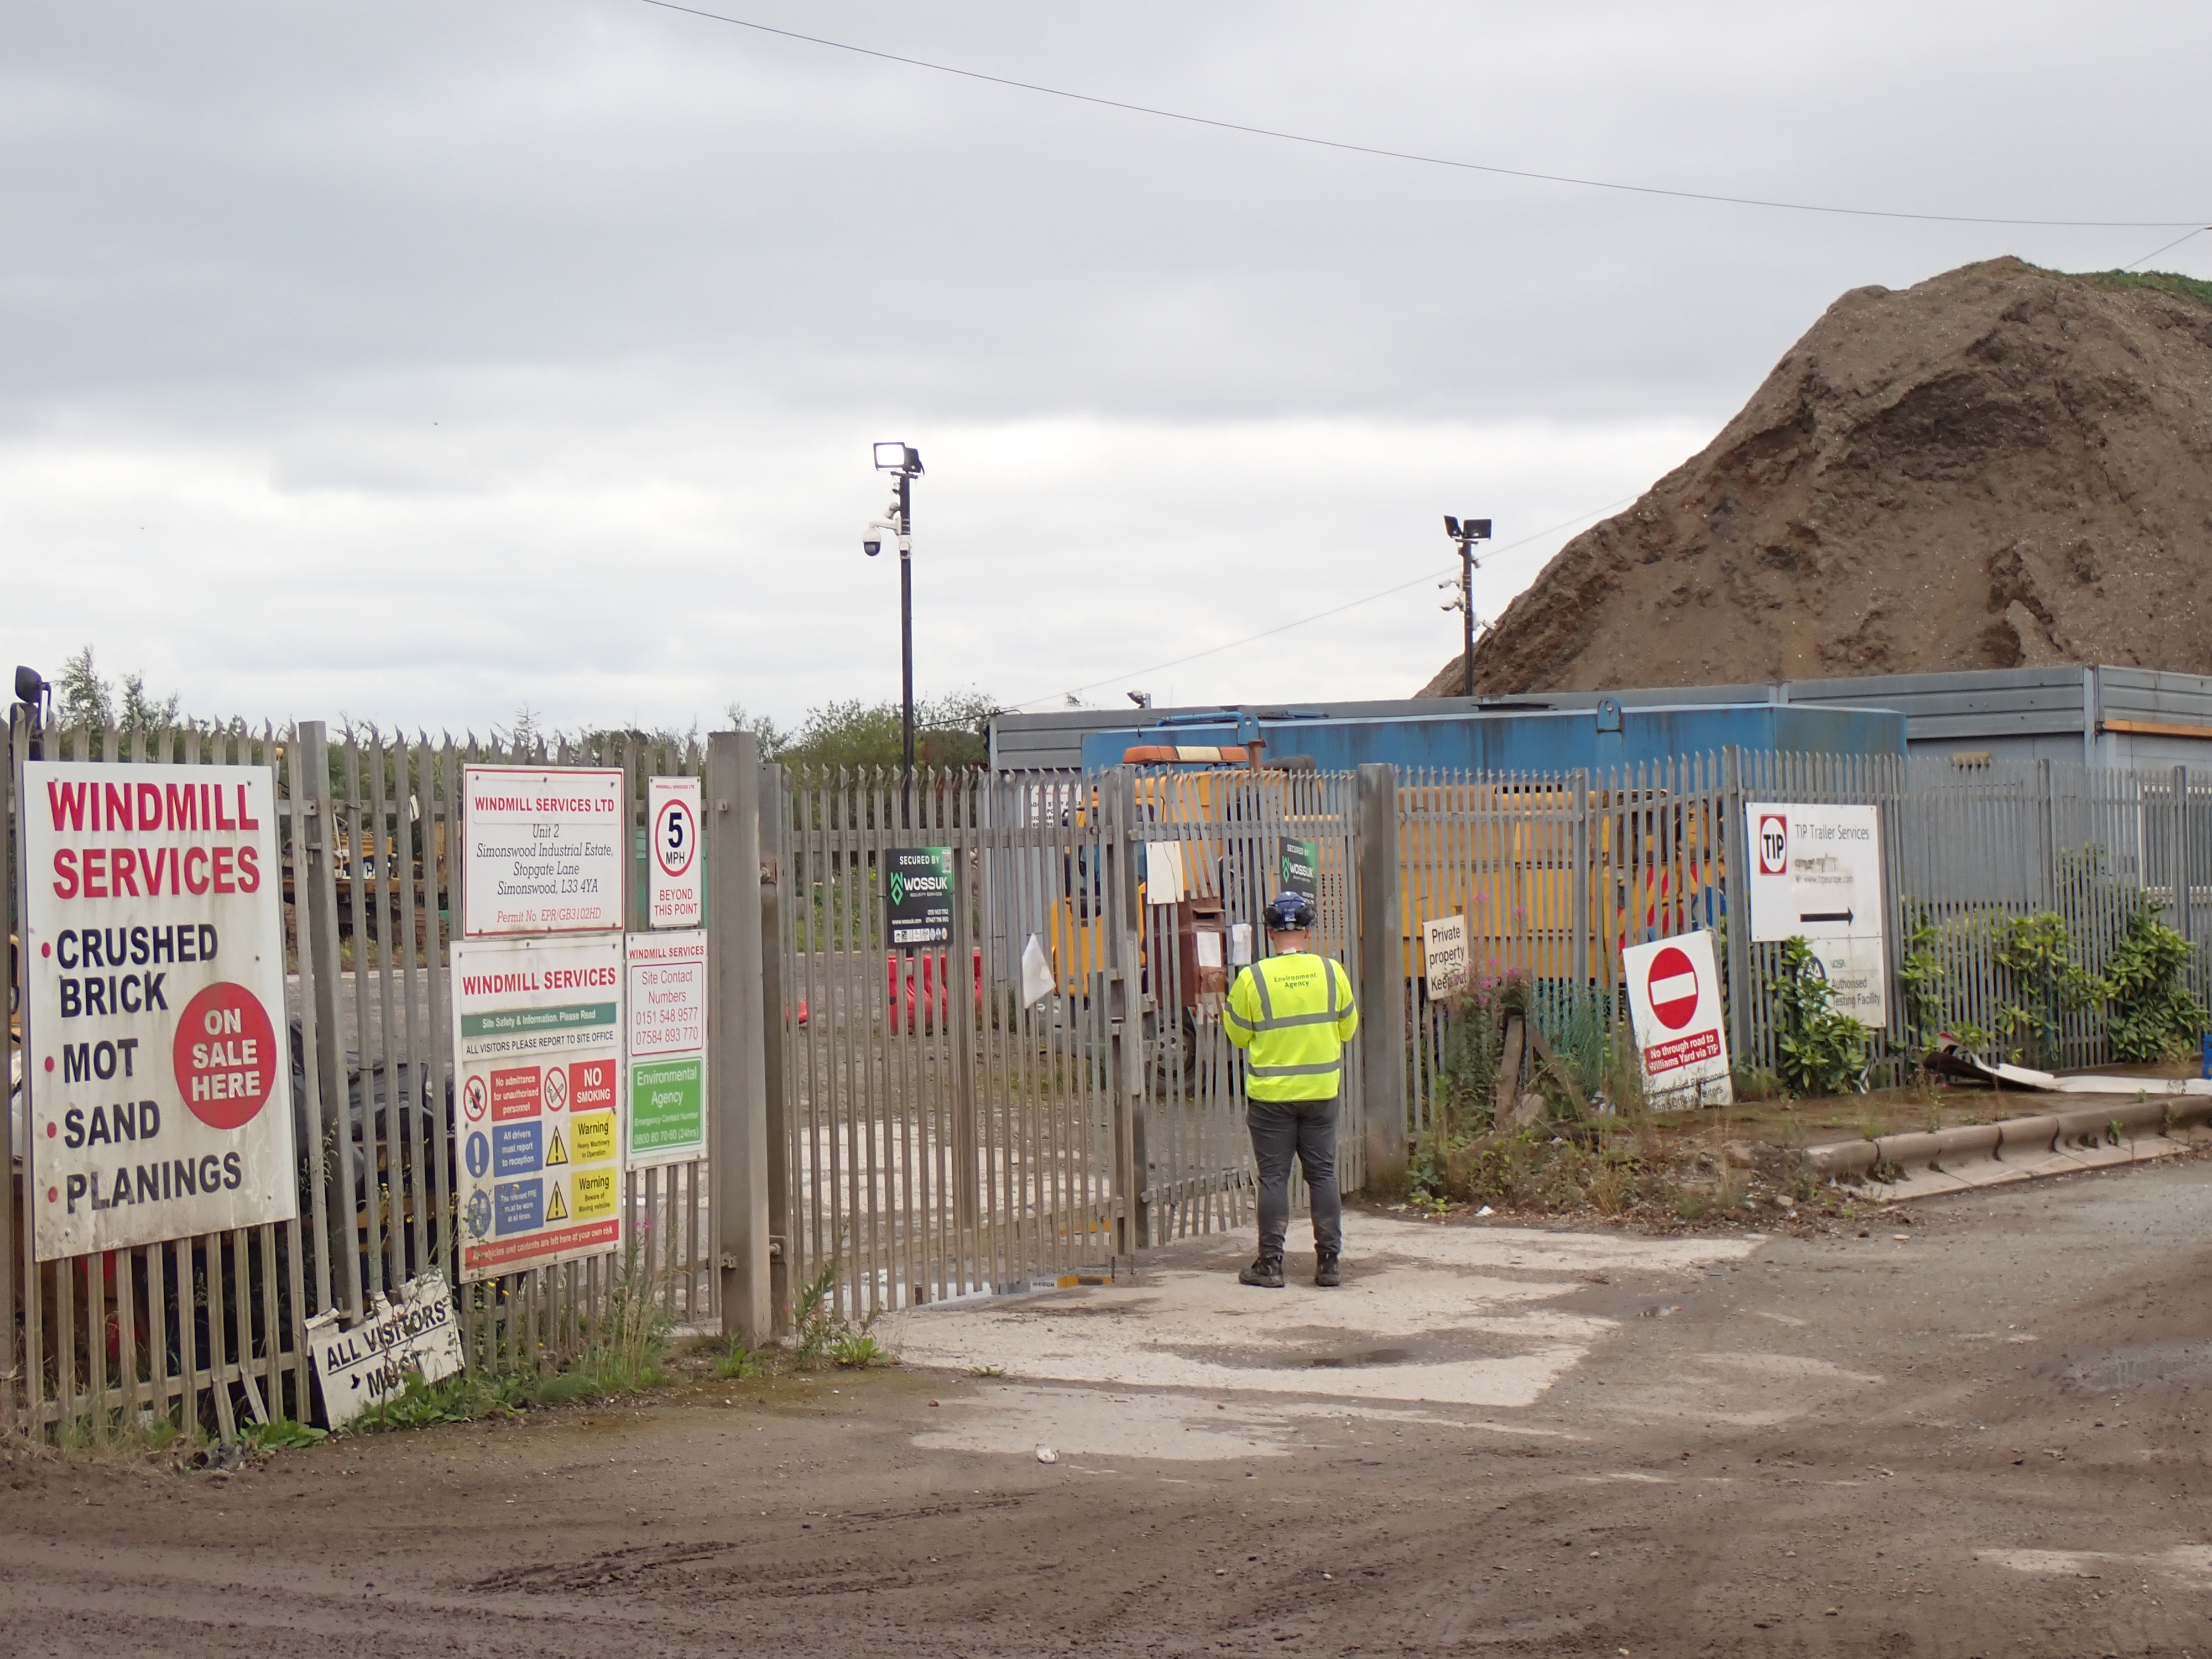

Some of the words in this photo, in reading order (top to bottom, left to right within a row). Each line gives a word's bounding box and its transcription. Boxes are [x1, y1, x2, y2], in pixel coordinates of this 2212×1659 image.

[48, 781, 259, 831] WINDMILL
[475, 797, 532, 811] WINDMILL
[536, 798, 591, 812] SERVICES
[596, 799, 614, 812] LTD
[533, 824, 551, 838] Unit
[554, 825, 560, 838] 2
[667, 812, 683, 848] 5
[1794, 825, 1807, 838] TIP
[1810, 825, 1835, 839] Trailer
[1838, 825, 1869, 839] Services
[477, 843, 536, 857] Simonswood
[539, 842, 582, 857] Industrial
[585, 842, 613, 857] Estate,
[1287, 844, 1303, 855] SECURED
[1763, 834, 1784, 859] TIP
[666, 852, 685, 865] MPH
[899, 855, 930, 865] SECURED
[931, 855, 940, 864] BY
[53, 846, 260, 899] SERVICES
[514, 862, 554, 879] Stopgate
[557, 861, 580, 875] Lane
[1290, 862, 1313, 878] WOSSUK
[498, 880, 557, 895] Simonswood,
[561, 879, 578, 893] L33
[581, 879, 598, 893] 4YA
[904, 877, 948, 891] WOSSUK
[660, 889, 693, 901] BEYOND
[497, 910, 524, 922] Permit
[526, 910, 536, 922] No
[655, 904, 672, 916] THIS
[675, 903, 698, 915] POINT
[1432, 925, 1460, 943] Private
[57, 924, 218, 969] CRUSHED
[629, 948, 667, 959] WINDMILL
[669, 945, 704, 957] SERVICES
[1430, 945, 1464, 968] property
[1830, 959, 1846, 968] VOSA
[463, 972, 539, 995] WINDMILL
[545, 967, 615, 989] SERVICES
[642, 971, 658, 985] Site
[661, 969, 693, 984] Contact
[1274, 973, 1317, 983] Environment
[1285, 980, 1309, 989] Agency
[1832, 977, 1866, 989] Authorised
[60, 973, 169, 1018] BRICK
[649, 990, 686, 1004] Numbers
[1832, 995, 1856, 1008] Testing
[1858, 992, 1880, 1006] Facility
[205, 1008, 241, 1035] ON
[483, 1018, 494, 1029] Site
[496, 1016, 515, 1029] Safety
[517, 1015, 521, 1025] &
[560, 1011, 580, 1022] Please
[581, 1009, 596, 1019] Read
[636, 1011, 656, 1025] 0151
[660, 1009, 675, 1023] 548
[678, 1007, 698, 1021] 9577
[467, 1044, 479, 1055] ALL
[481, 1041, 510, 1053] VISITORS
[512, 1039, 537, 1050] PLEASE
[539, 1036, 565, 1047] REPORT
[567, 1035, 575, 1044] TO
[577, 1033, 590, 1042] SITE
[592, 1031, 613, 1041] OFFICE
[636, 1030, 662, 1045] 07584
[665, 1028, 680, 1042] 893
[683, 1026, 698, 1041] 770
[192, 1039, 258, 1069] SALE
[1651, 1049, 1661, 1059] No
[1662, 1040, 1688, 1058] through
[1690, 1035, 1705, 1048] road
[1706, 1034, 1714, 1042] to
[64, 1038, 138, 1083] MOT
[1649, 1057, 1678, 1072] Williams
[1679, 1052, 1695, 1063] Yard
[1696, 1048, 1706, 1058] via
[1707, 1044, 1719, 1055] TIP
[496, 1078, 504, 1087] No
[505, 1075, 535, 1085] admittance
[584, 1067, 602, 1087] NO
[637, 1066, 697, 1086] Environmental
[192, 1071, 261, 1102] HERE
[503, 1087, 539, 1100] unauthorised
[577, 1088, 611, 1103] SMOKING
[651, 1091, 683, 1108] Agency
[503, 1102, 530, 1116] personnel
[64, 1100, 160, 1149] SAND
[578, 1121, 608, 1135] Warning
[512, 1130, 531, 1139] drivers
[660, 1130, 668, 1140] 70
[502, 1145, 515, 1154] must
[517, 1142, 533, 1152] report
[509, 1155, 534, 1166] reception
[67, 1151, 242, 1214] PLANINGS
[579, 1175, 609, 1191] Warning
[327, 1338, 361, 1371] ALL
[363, 1300, 446, 1352] VISITORS
